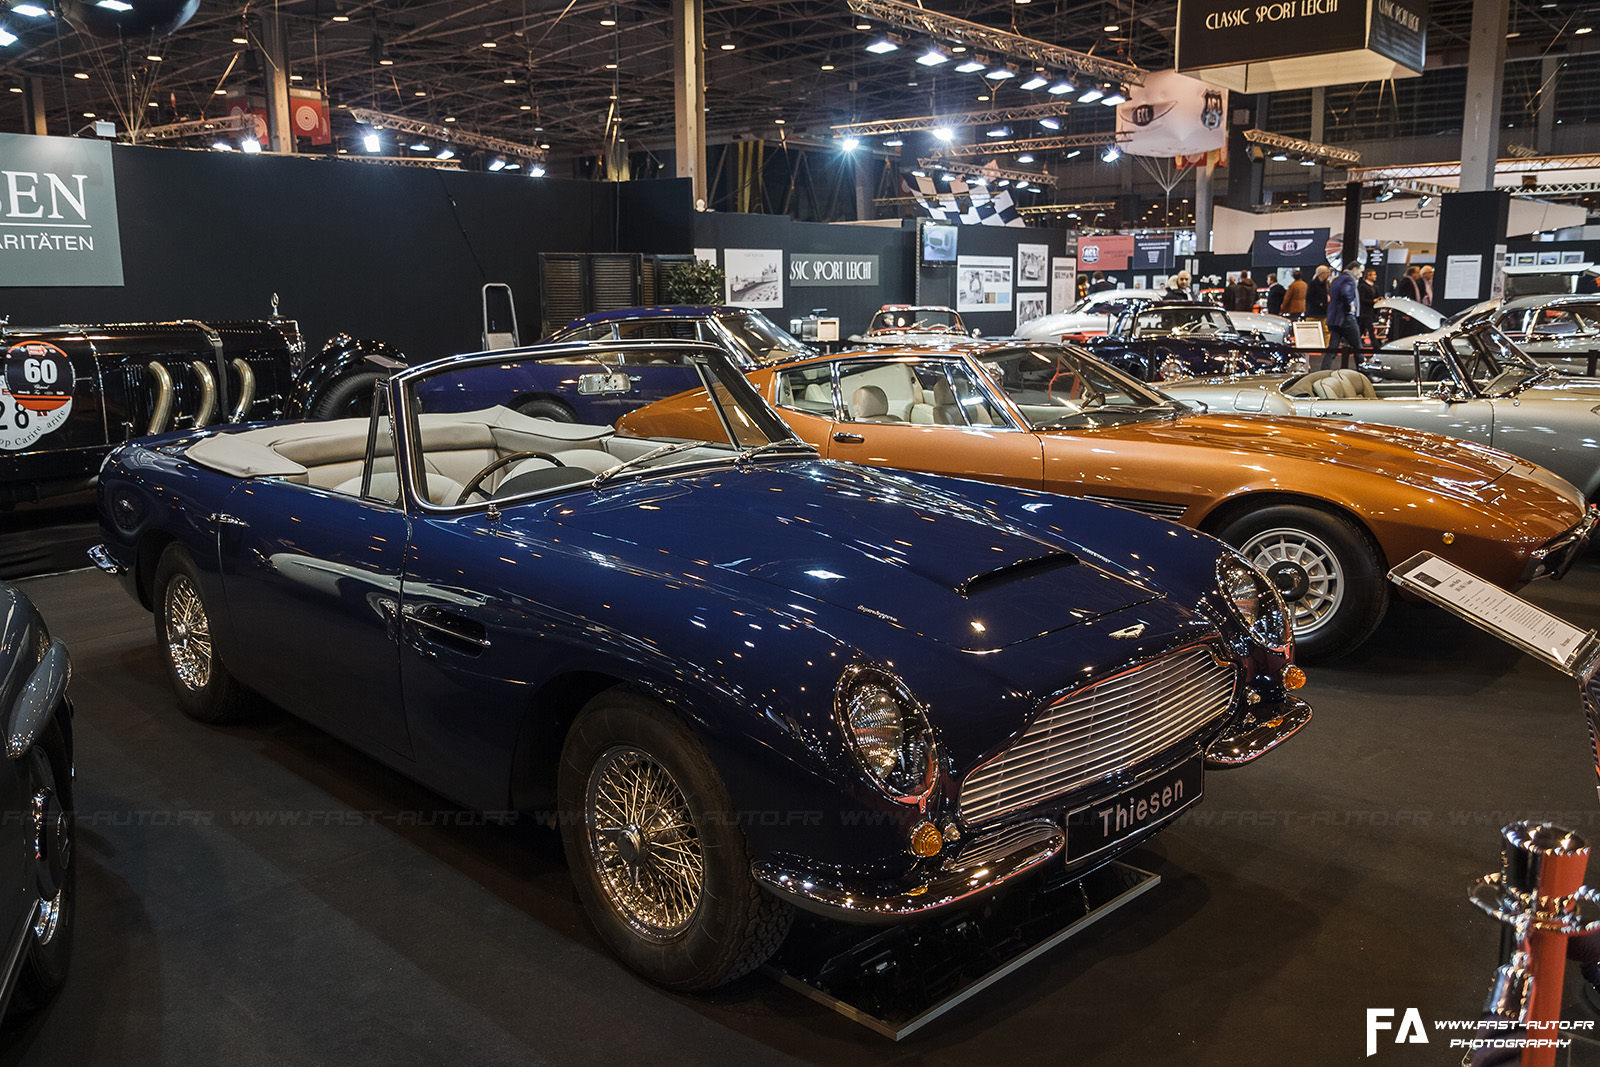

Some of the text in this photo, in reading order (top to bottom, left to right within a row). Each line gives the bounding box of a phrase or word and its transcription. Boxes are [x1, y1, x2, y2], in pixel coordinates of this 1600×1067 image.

[1205, 8, 1250, 30] CLASSIC
[1255, 1, 1296, 24] SPORT
[0, 170, 88, 220] EN
[0, 232, 94, 251] RITÄTEN
[813, 261, 843, 280] SPORT
[846, 261, 872, 280] LEICHT
[24, 358, 57, 384] 60
[1099, 779, 1183, 838] Thiesen
